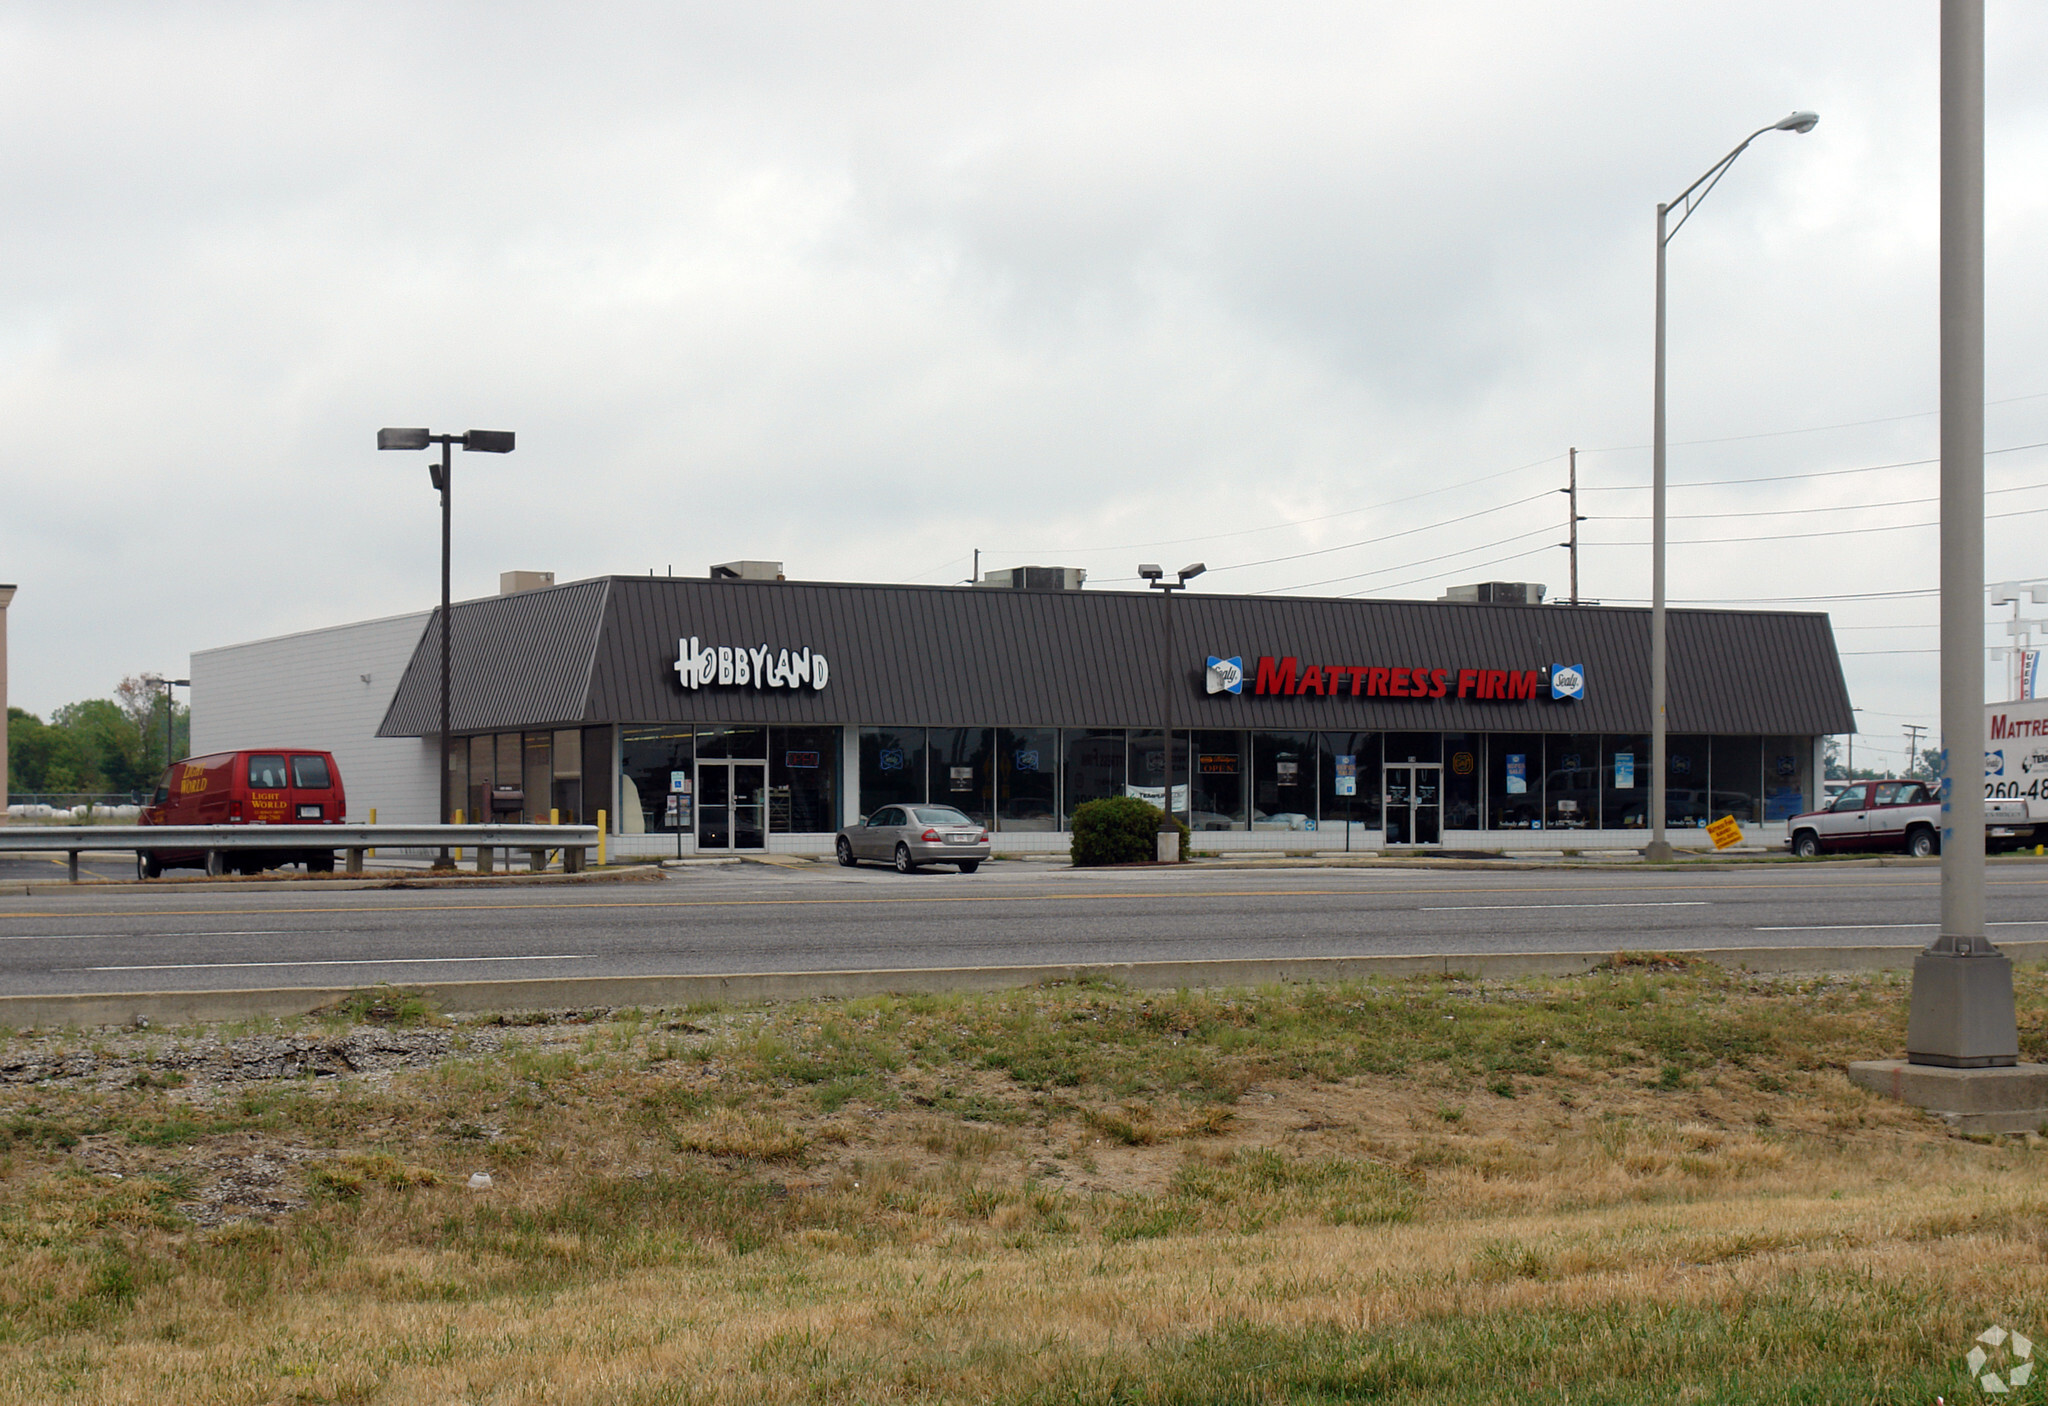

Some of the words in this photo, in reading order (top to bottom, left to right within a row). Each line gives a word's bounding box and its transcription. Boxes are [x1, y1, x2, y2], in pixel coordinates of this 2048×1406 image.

[674, 636, 829, 690] HOBBYLAND
[2024, 653, 2034, 685] USED
[1255, 656, 1448, 699] MATTRESS
[1457, 669, 1538, 699] FIRM
[1556, 674, 1578, 689] Sealy
[1991, 714, 2048, 740] MATTRE
[183, 763, 207, 779] LIGHT
[181, 778, 207, 793] WORLD
[252, 792, 280, 800] LIGHT
